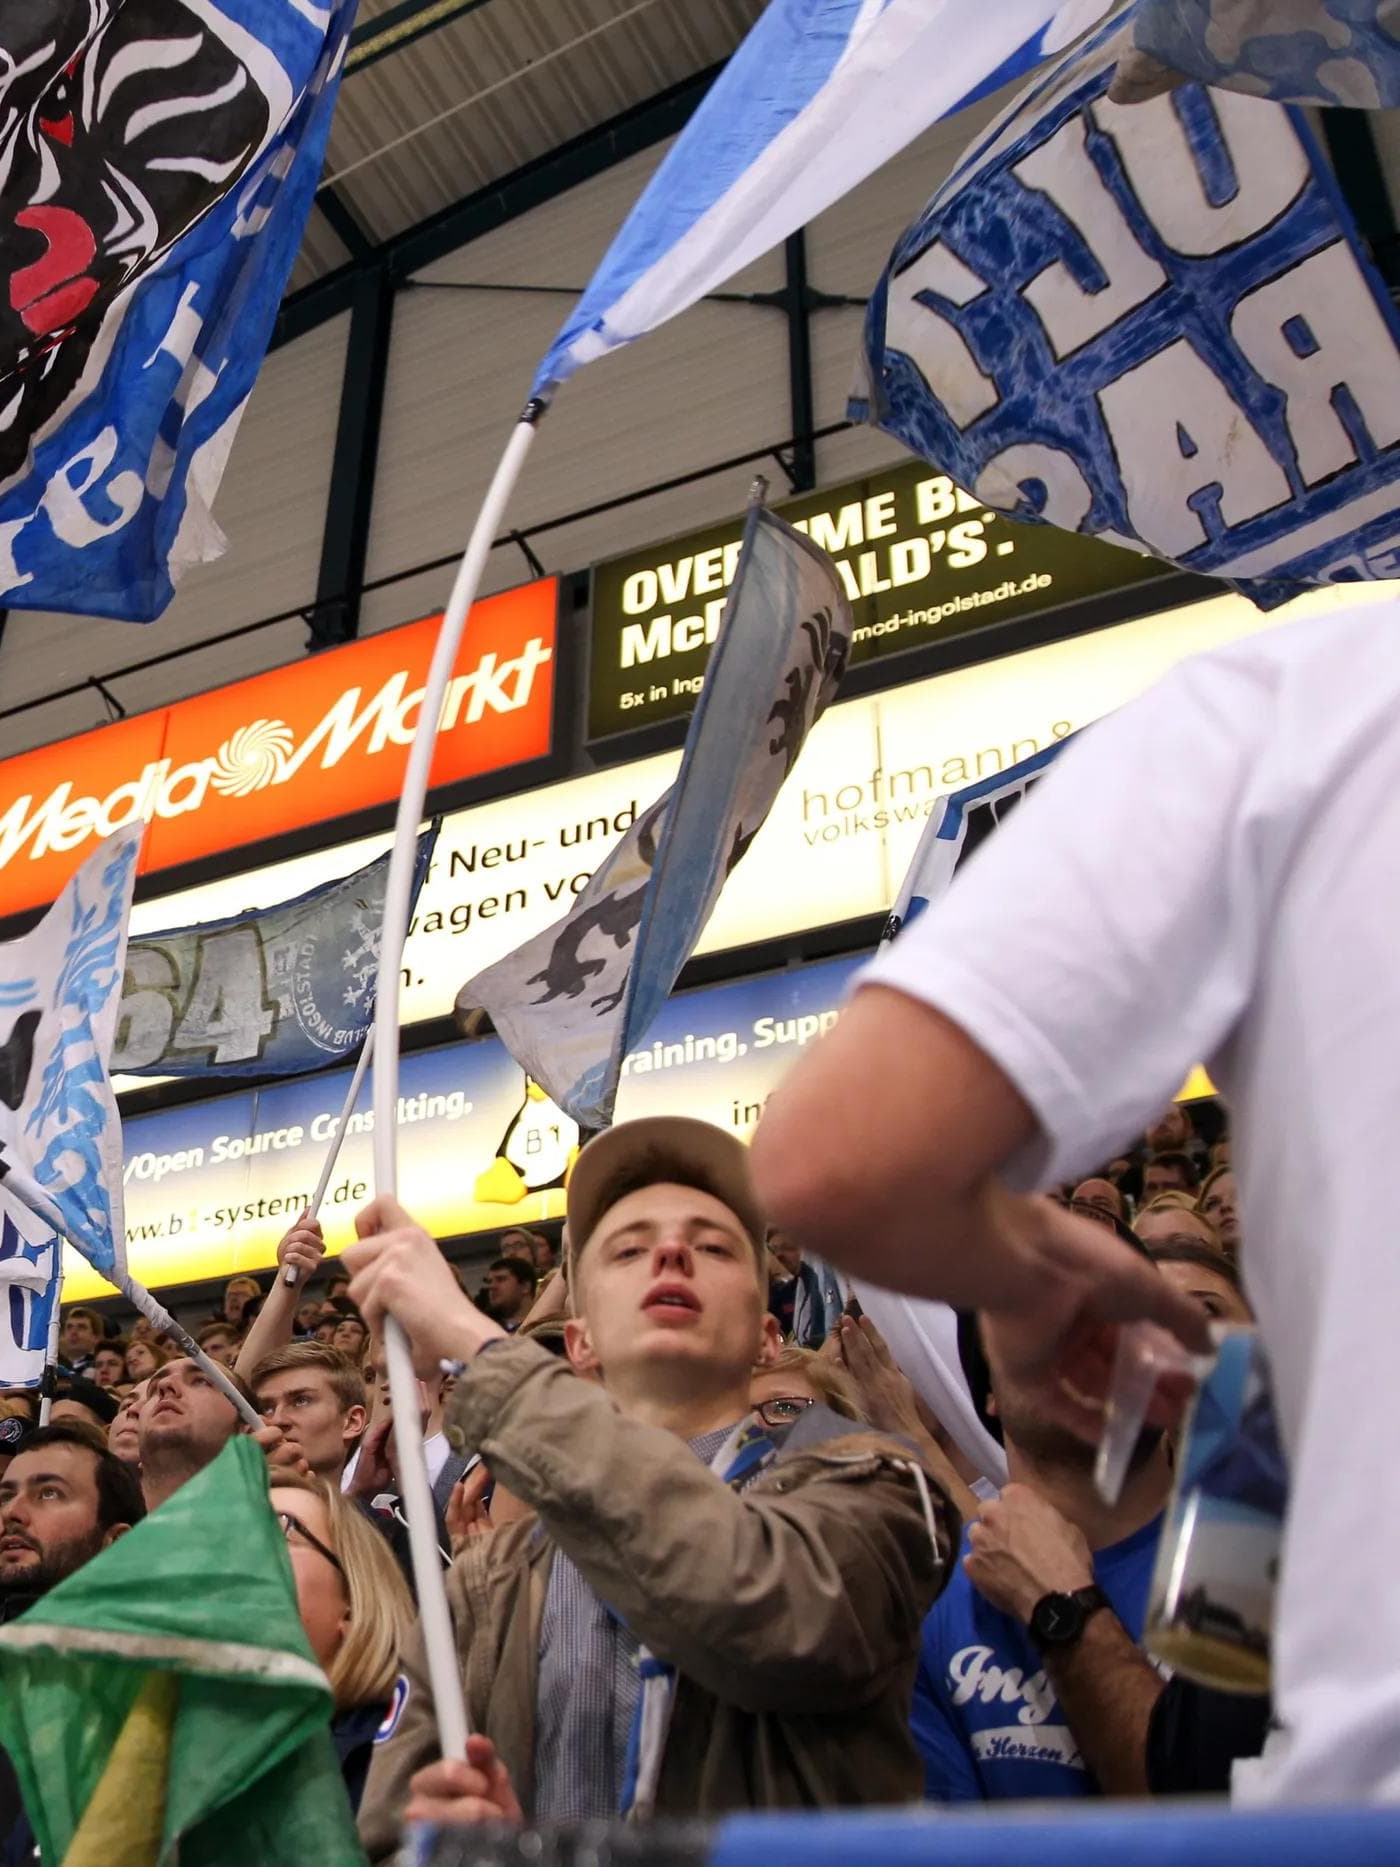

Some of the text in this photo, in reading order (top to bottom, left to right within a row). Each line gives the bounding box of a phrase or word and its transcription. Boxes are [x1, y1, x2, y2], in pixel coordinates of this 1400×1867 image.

[619, 675, 705, 710] 5x in Ing
[803, 737, 1038, 821] hofmann
[450, 838, 546, 877] Neu-
[559, 800, 637, 847] und
[803, 797, 933, 847] volkswa
[543, 872, 593, 901] vo
[621, 1010, 839, 1077] raining, Supp
[123, 1091, 474, 1185] /Open Source Conslting,
[123, 1178, 367, 1245] ww.b1-system.de
[948, 1645, 1056, 1725] Ing
[987, 1735, 1062, 1759] Herzen
